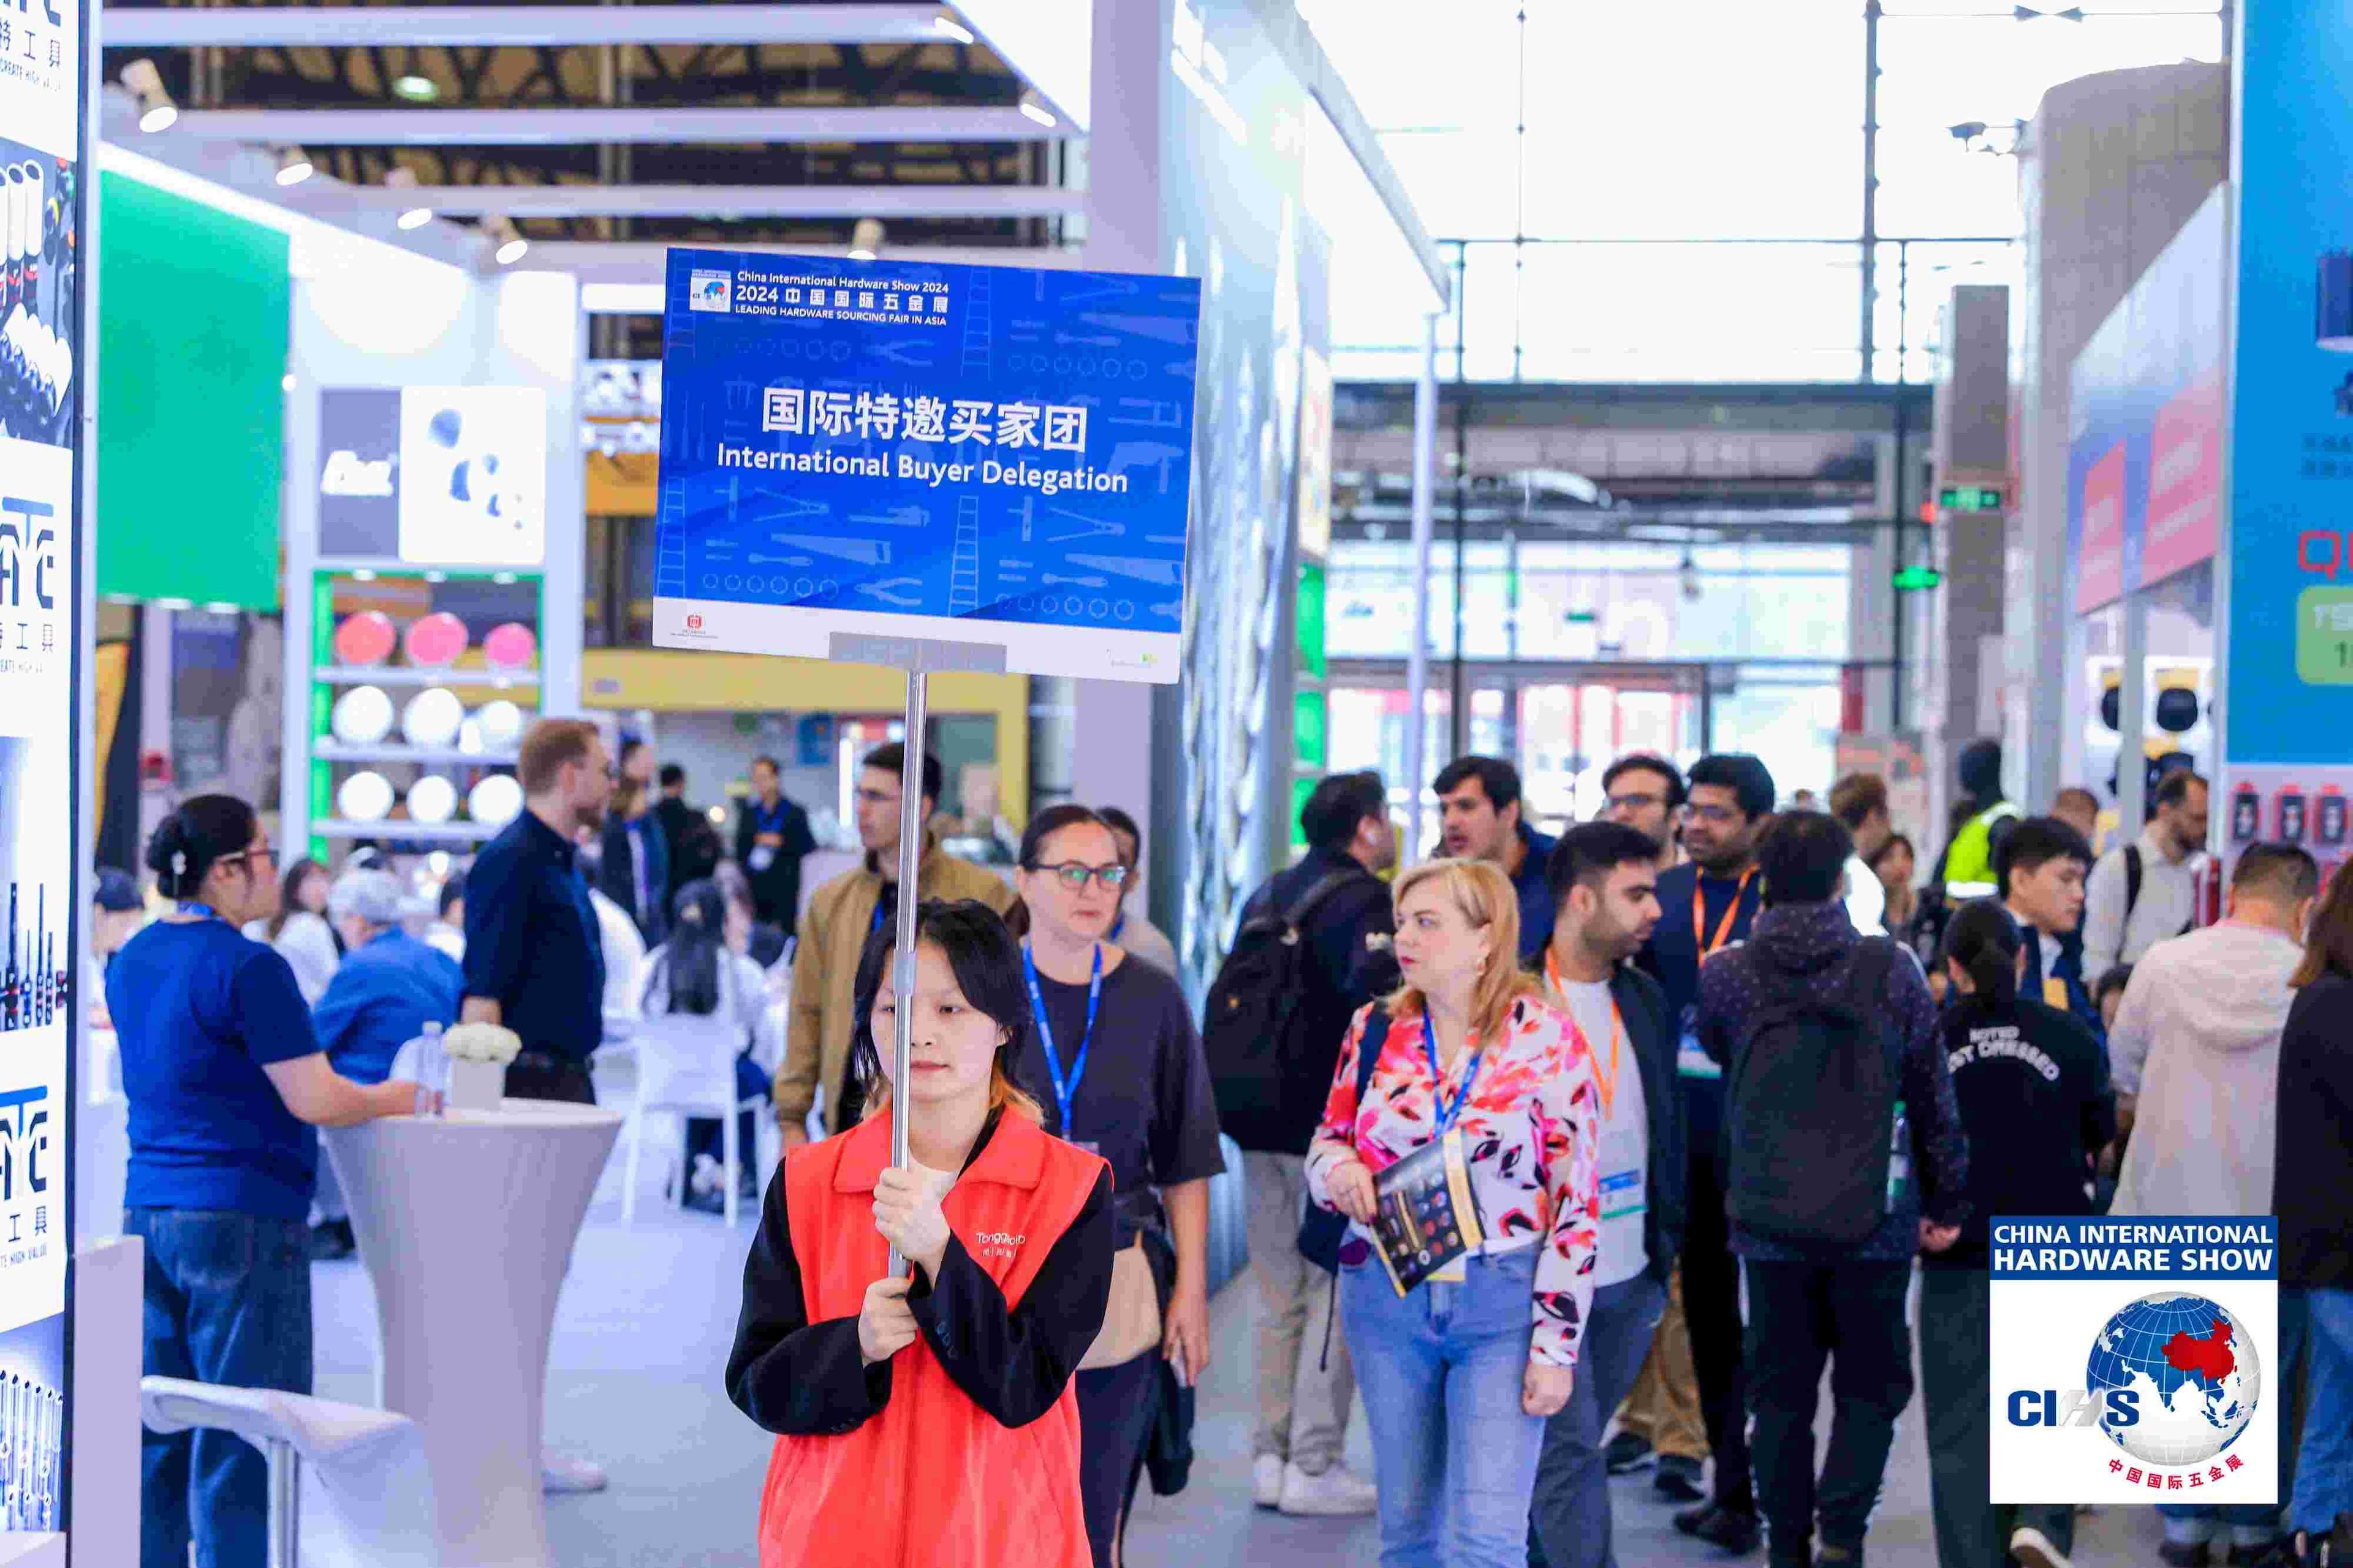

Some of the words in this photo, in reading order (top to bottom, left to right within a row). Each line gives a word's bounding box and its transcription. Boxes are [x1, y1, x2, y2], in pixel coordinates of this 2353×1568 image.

[737, 271, 767, 282] China
[770, 273, 836, 287] International
[839, 277, 889, 289] Hardware
[892, 280, 919, 292] Show
[922, 282, 949, 294] 2024
[736, 285, 778, 303] 2024
[785, 288, 949, 313] 中国国际五金展
[735, 305, 777, 316] LEADING
[779, 307, 833, 319] HARDWARE
[836, 311, 886, 322] SOURCING
[889, 314, 909, 324] FAIR
[912, 316, 922, 325] IN
[924, 316, 947, 326] ASIA
[762, 387, 1087, 453] 国际特邀买家团
[718, 442, 889, 477] International
[898, 453, 975, 488] Buyer
[982, 460, 1128, 495] Delegation
